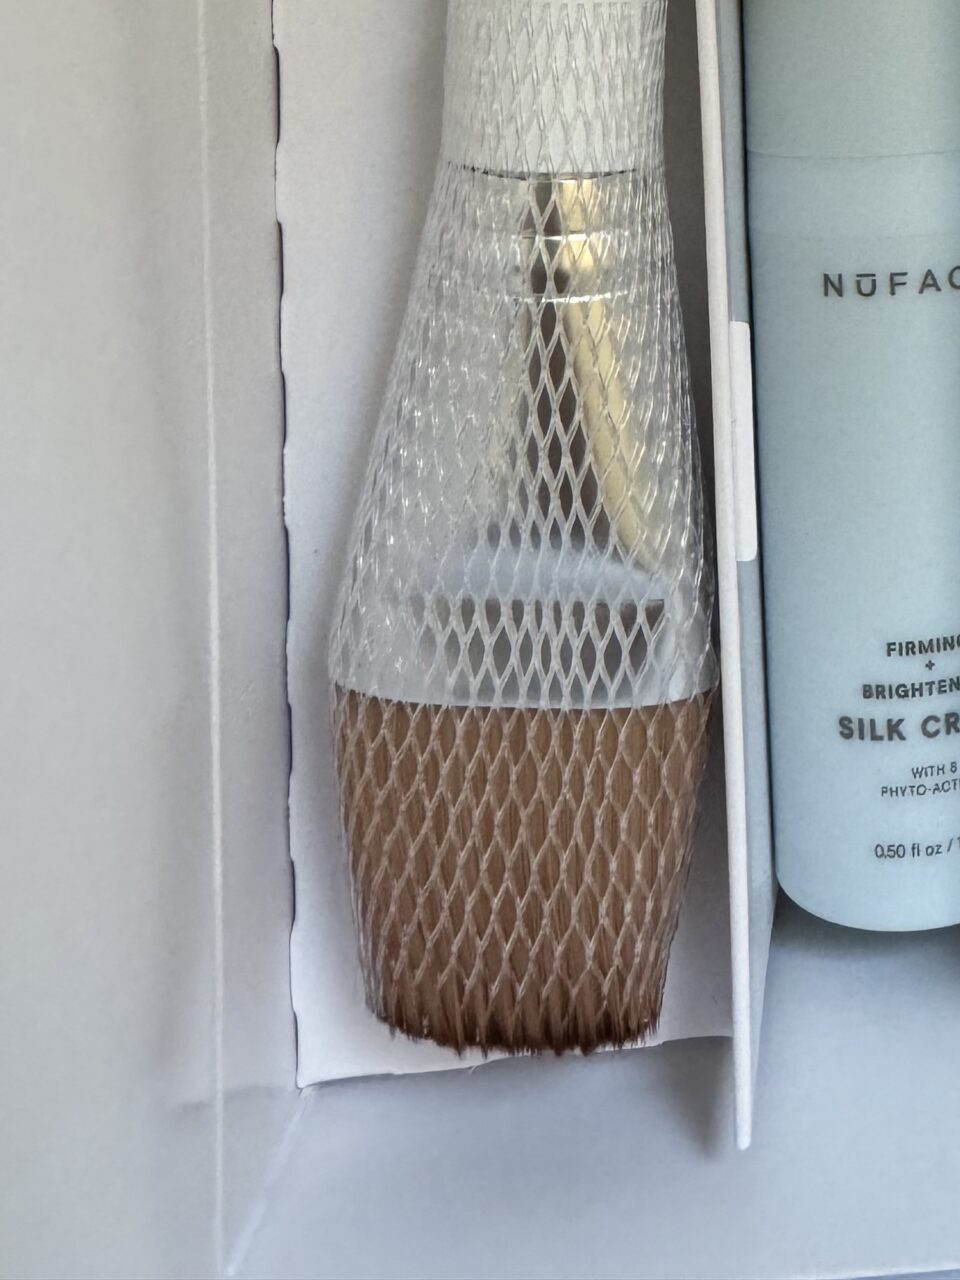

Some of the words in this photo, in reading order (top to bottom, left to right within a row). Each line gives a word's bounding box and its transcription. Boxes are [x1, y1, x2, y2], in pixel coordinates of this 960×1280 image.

[838, 716, 907, 742] SILK
[911, 764, 945, 779] WITH
[950, 761, 957, 774] 8
[874, 844, 906, 859] 0.50
[911, 843, 921, 858] fl
[925, 844, 942, 856] oz
[947, 838, 953, 852] /
